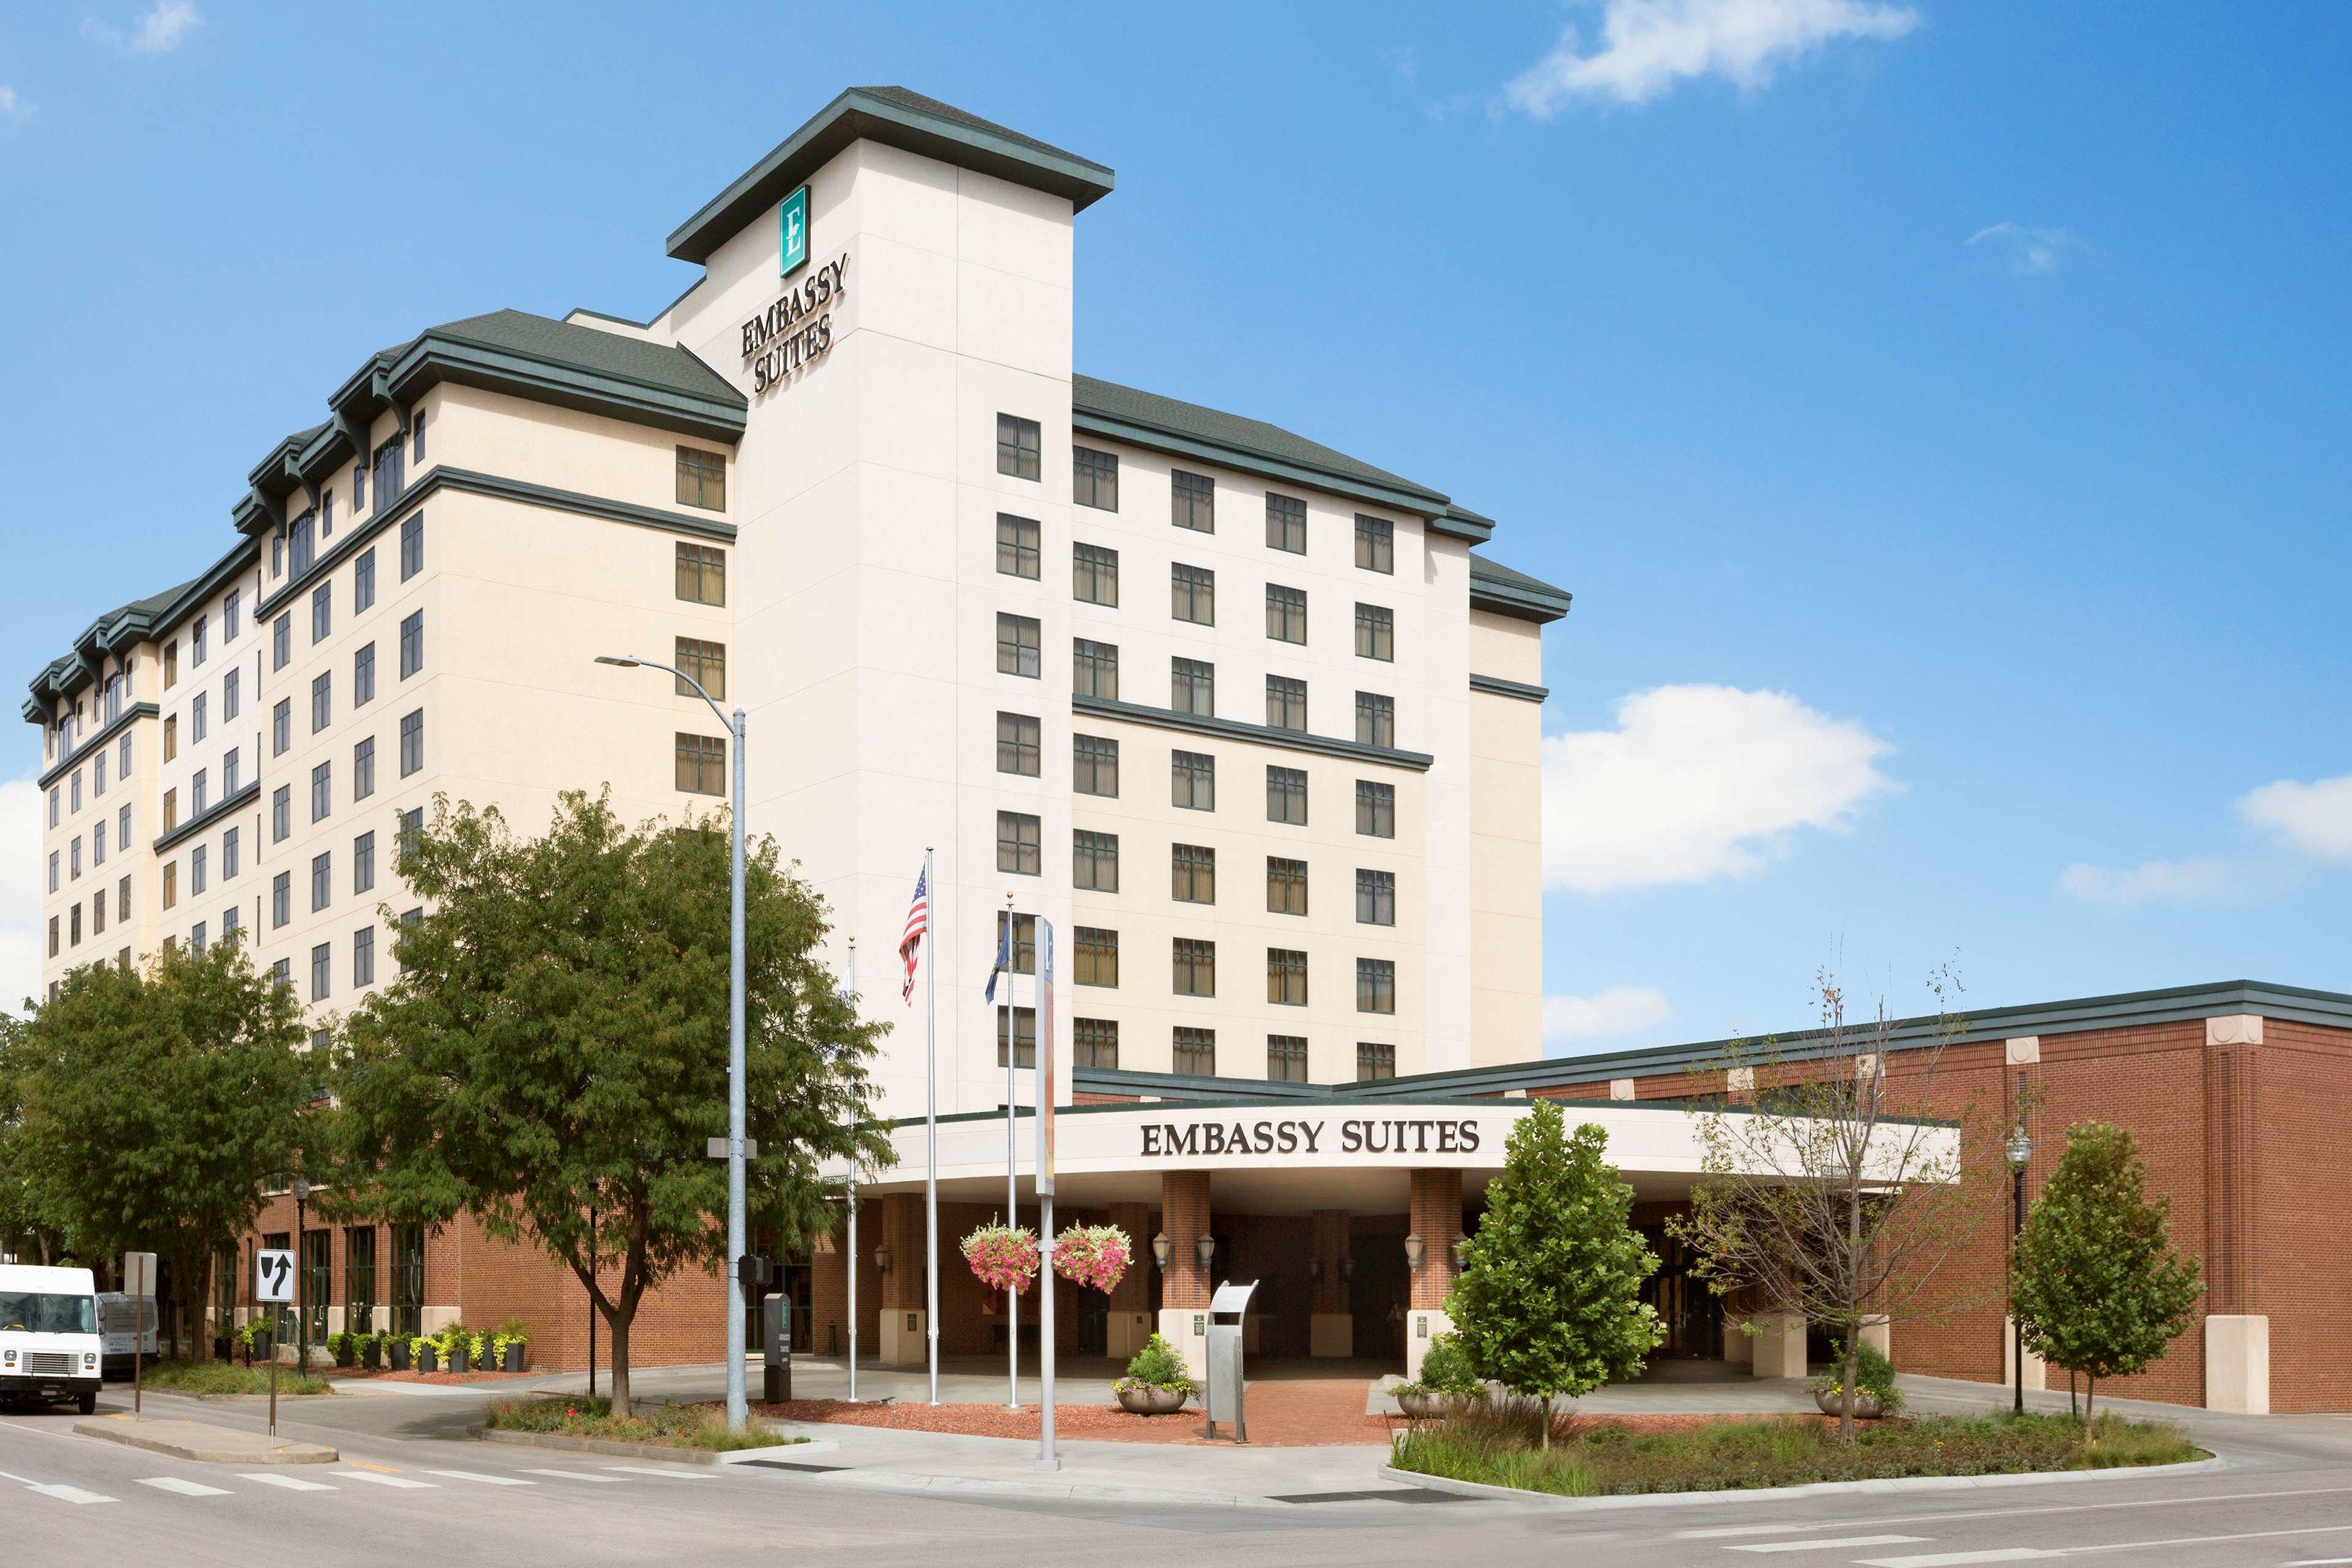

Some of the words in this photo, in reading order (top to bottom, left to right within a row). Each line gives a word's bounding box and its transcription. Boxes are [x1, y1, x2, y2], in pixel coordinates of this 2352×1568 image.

[786, 206, 801, 257] E
[741, 252, 849, 358] EMBASSY
[754, 313, 833, 393] SUITES
[1140, 1120, 1325, 1155] EMBASSY
[1341, 1119, 1480, 1153] SUITES
